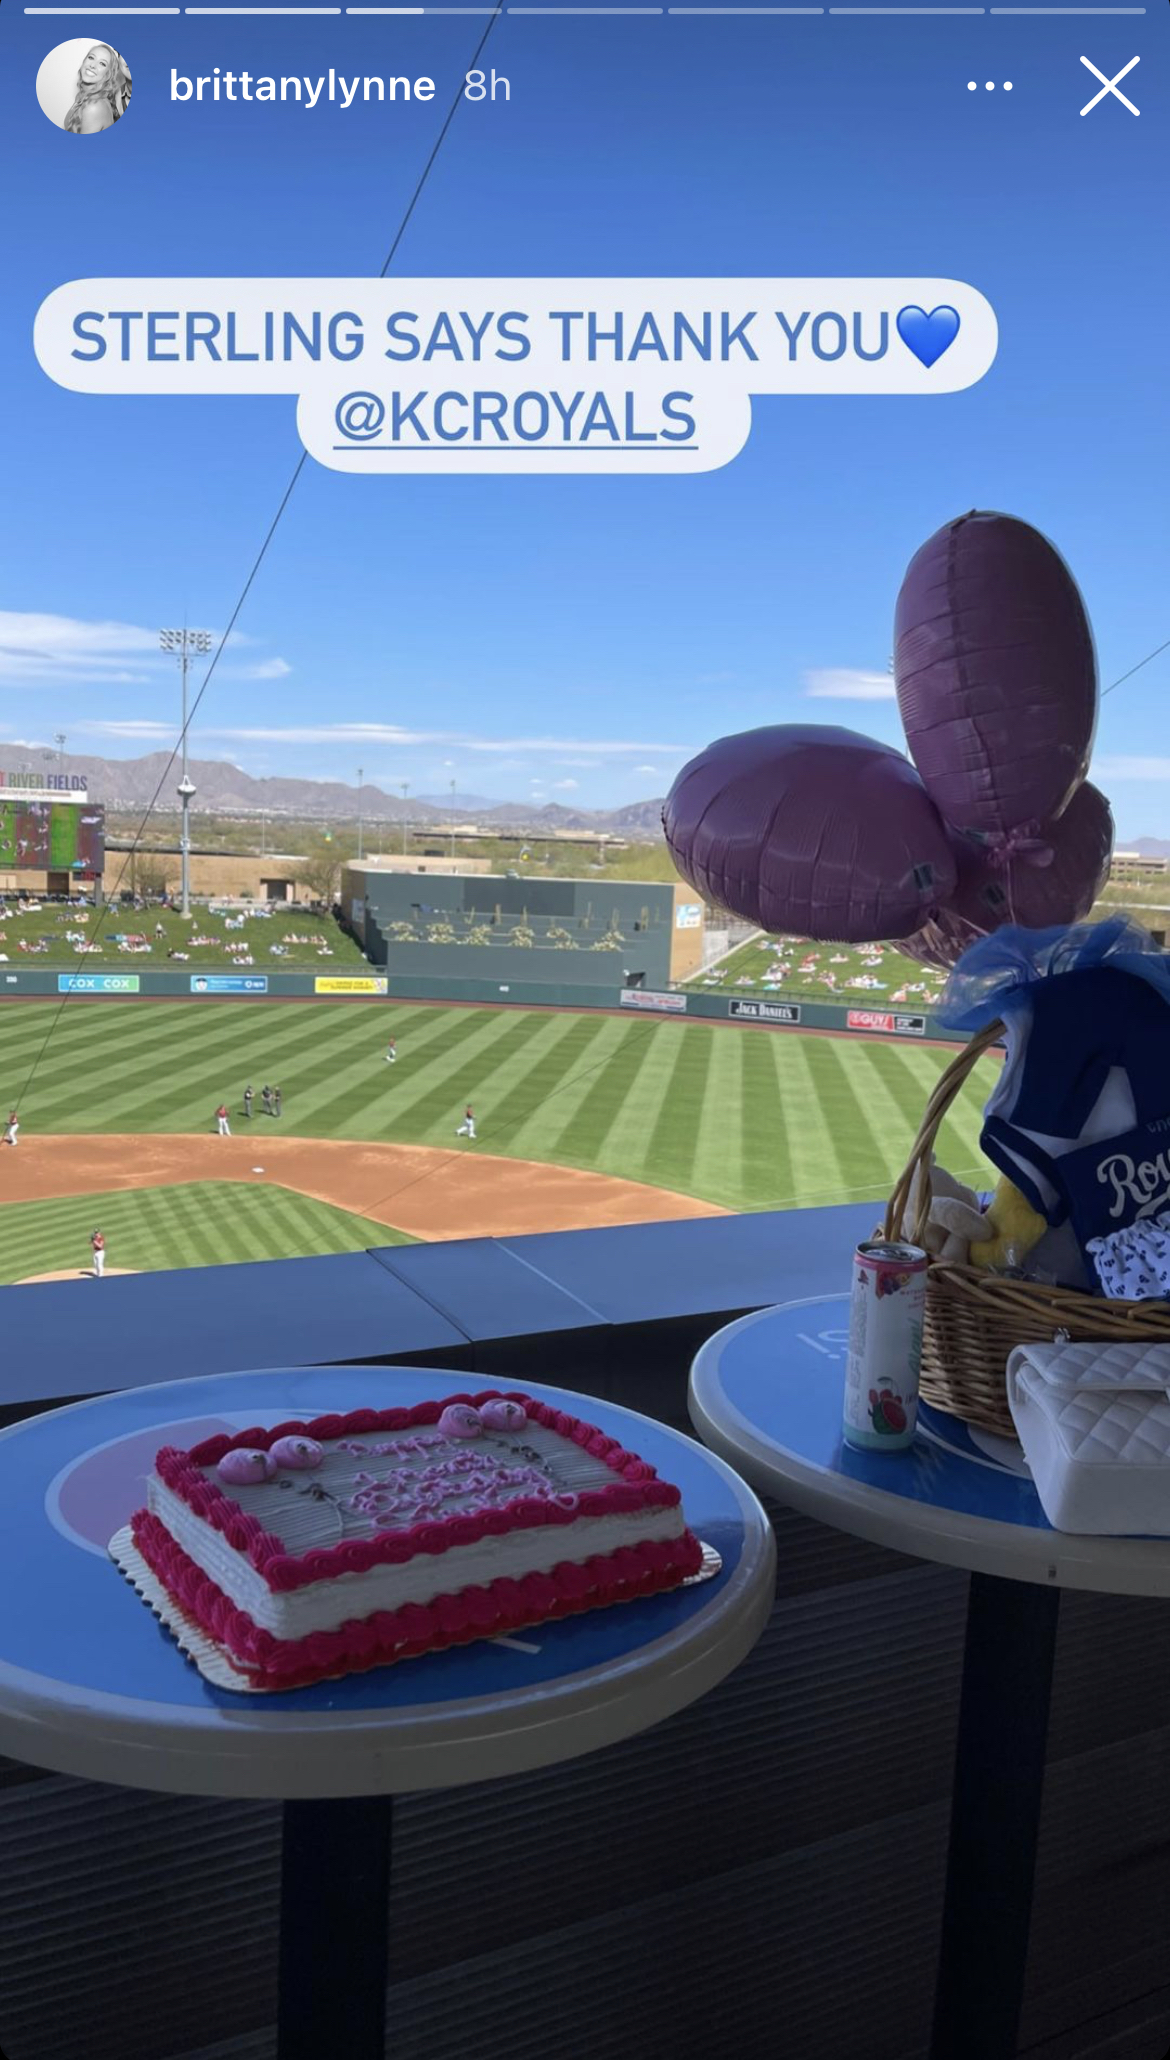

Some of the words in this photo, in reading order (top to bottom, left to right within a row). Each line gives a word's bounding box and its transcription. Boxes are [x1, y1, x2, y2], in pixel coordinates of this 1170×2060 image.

[8, 772, 43, 789] RIVER
[47, 774, 88, 791] FIELDS
[68, 978, 95, 988] COX
[103, 978, 130, 988] COX
[735, 1001, 757, 1015] JACK
